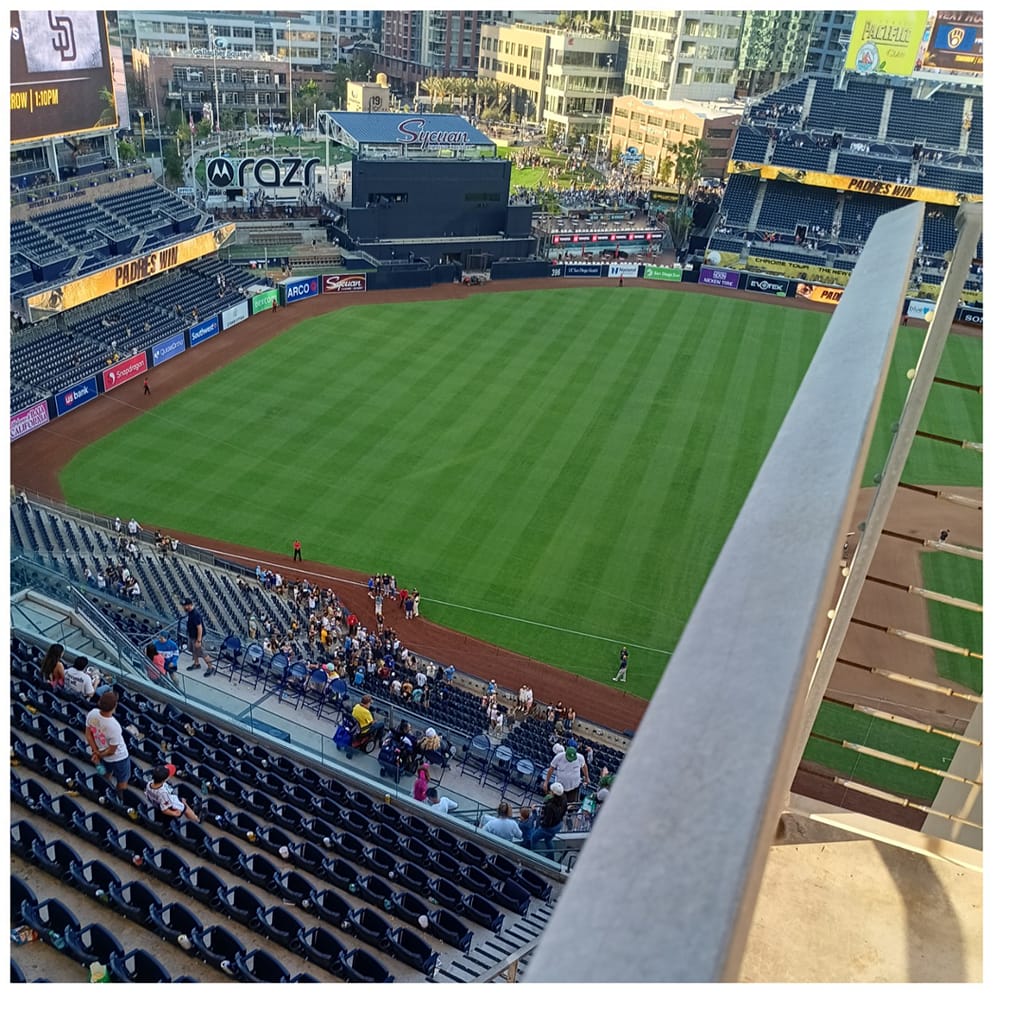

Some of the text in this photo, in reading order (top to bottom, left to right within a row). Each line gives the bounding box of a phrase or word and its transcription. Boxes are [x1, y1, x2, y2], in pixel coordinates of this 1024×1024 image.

[35, 88, 59, 107] 1:10PM
[397, 117, 468, 150] Sycuan
[238, 157, 320, 187] razr
[848, 178, 915, 198] PADRES WIN
[115, 246, 178, 287] PADRES WIN
[287, 283, 310, 298] ARCO
[325, 276, 361, 291] Sycuan
[191, 323, 215, 340] Southwest
[116, 360, 145, 379] Snapdragon
[73, 385, 89, 400] bank
